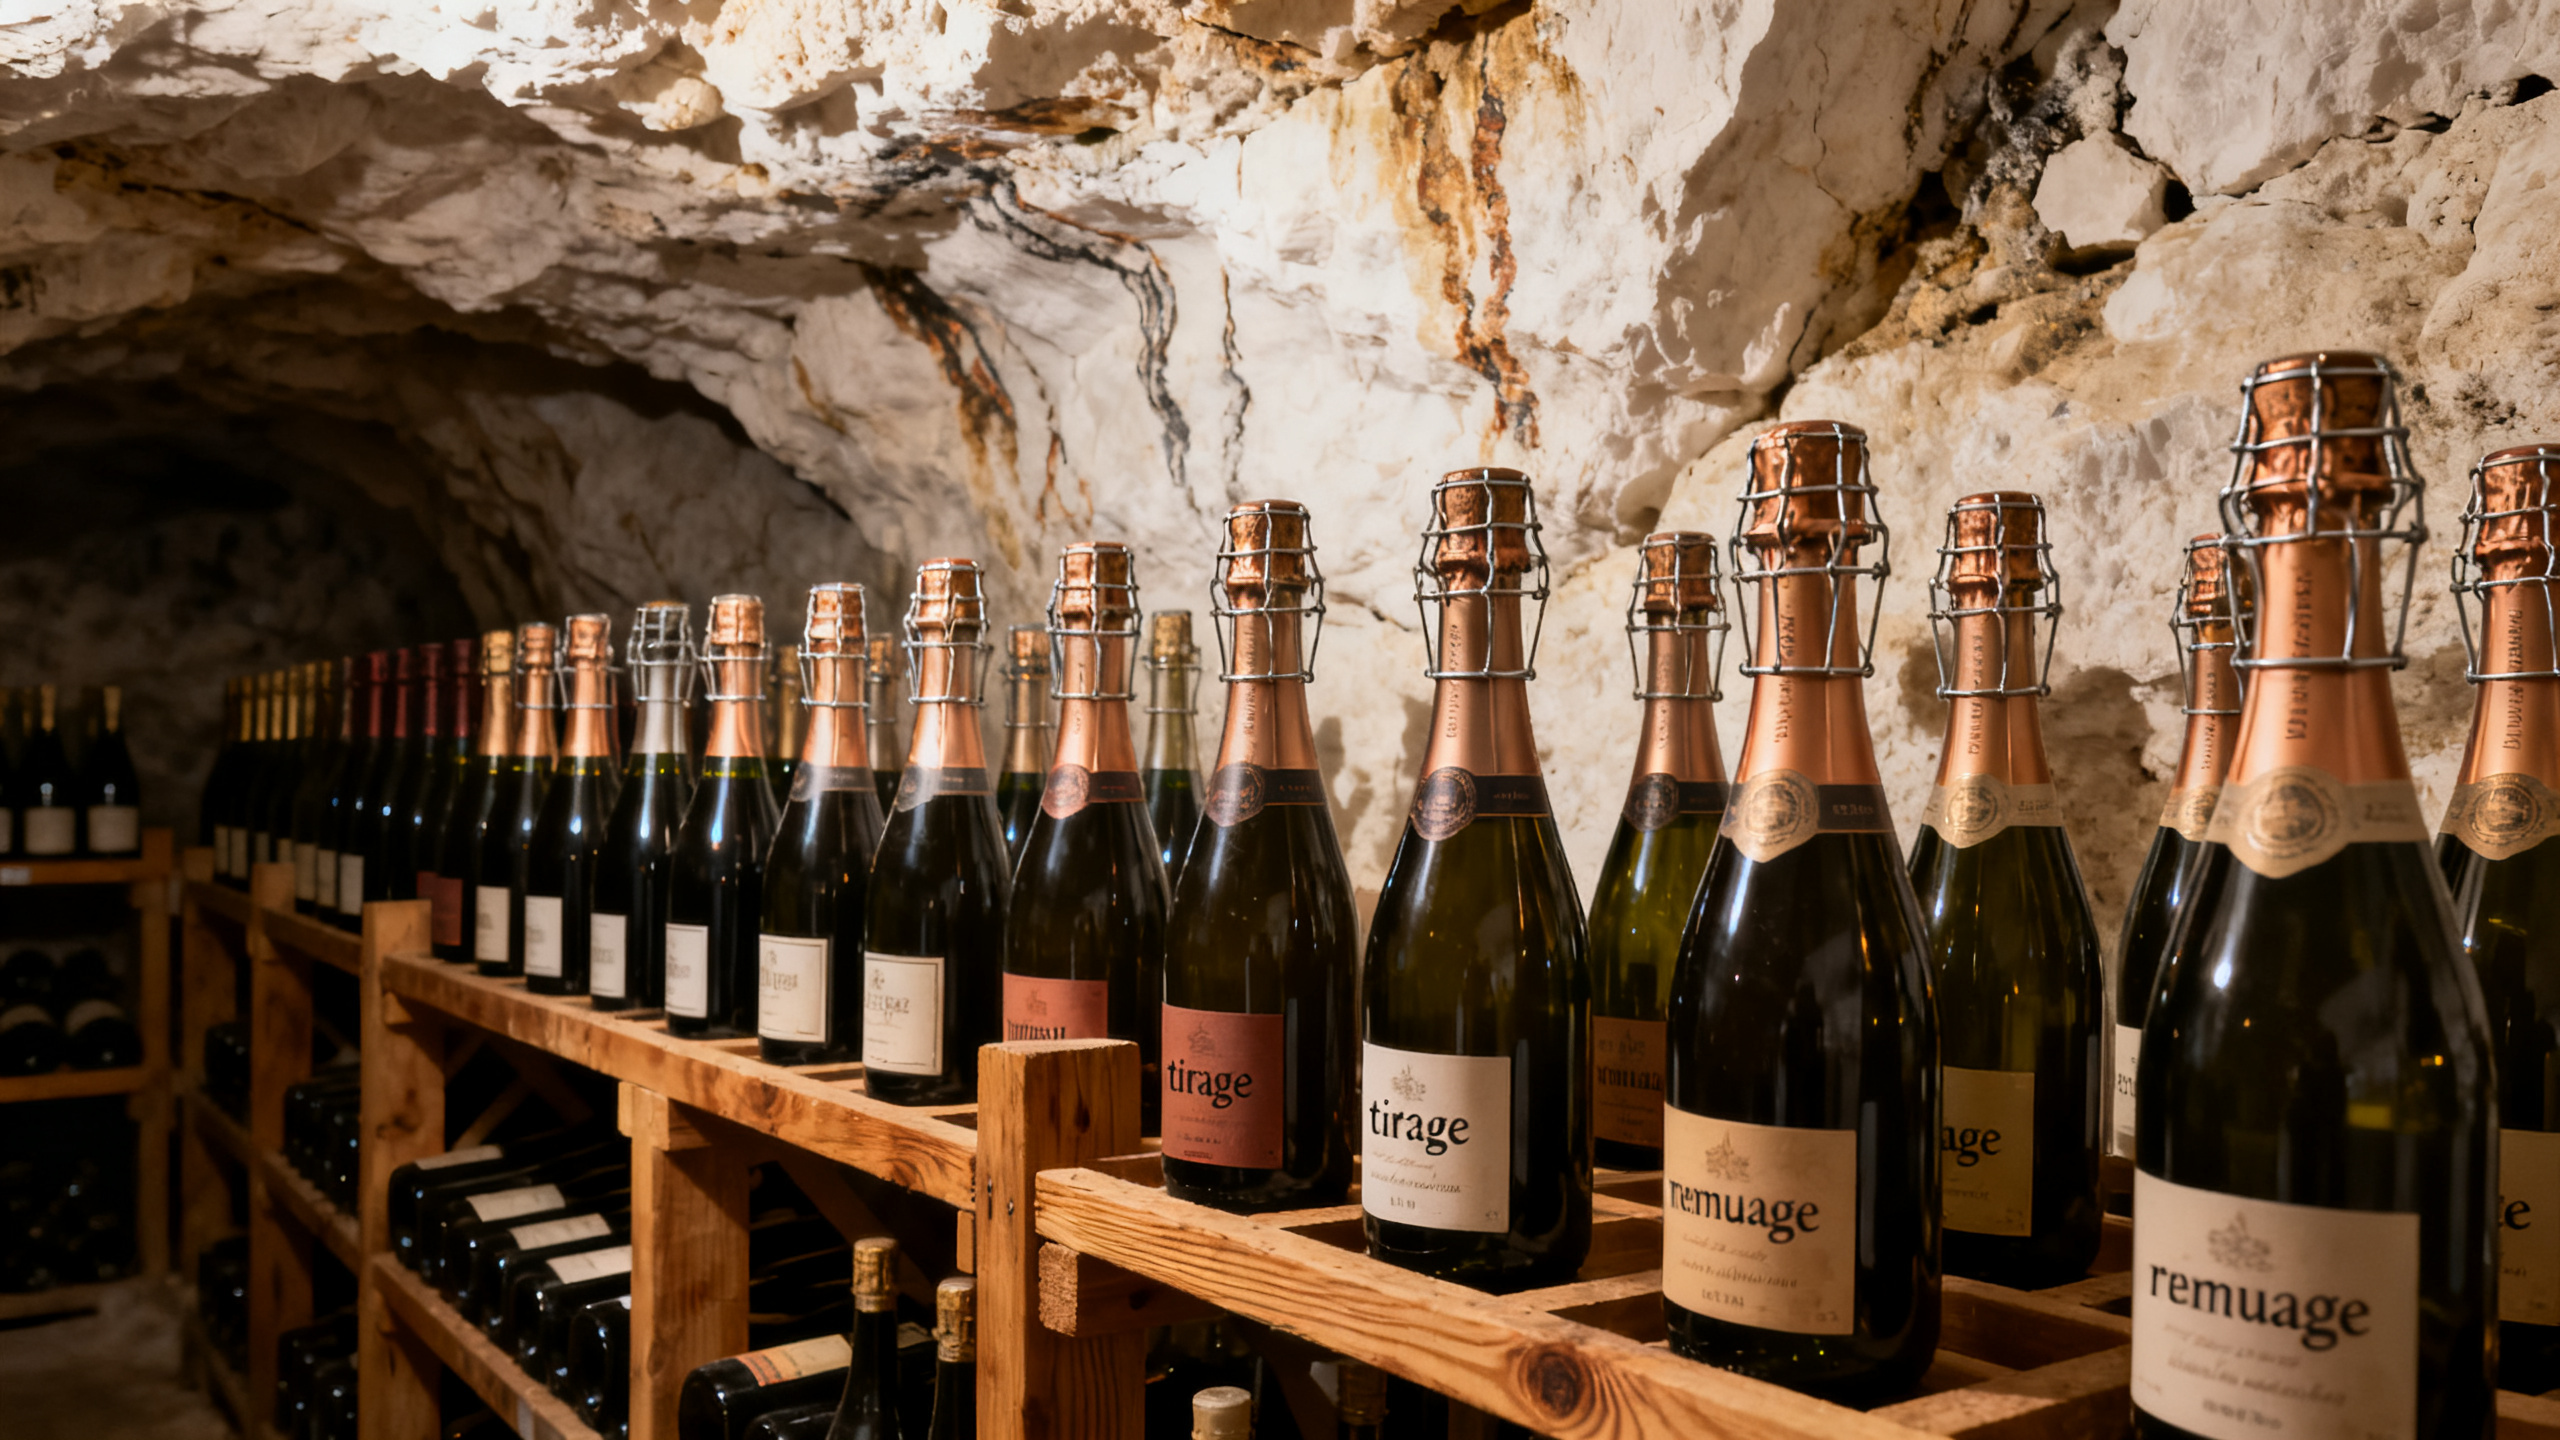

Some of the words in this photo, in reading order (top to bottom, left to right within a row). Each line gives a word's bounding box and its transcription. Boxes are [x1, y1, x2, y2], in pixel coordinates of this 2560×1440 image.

[1167, 1059, 1253, 1109] tirage
[1369, 1099, 1470, 1156] tirage
[2149, 1263, 2371, 1352] remuage
